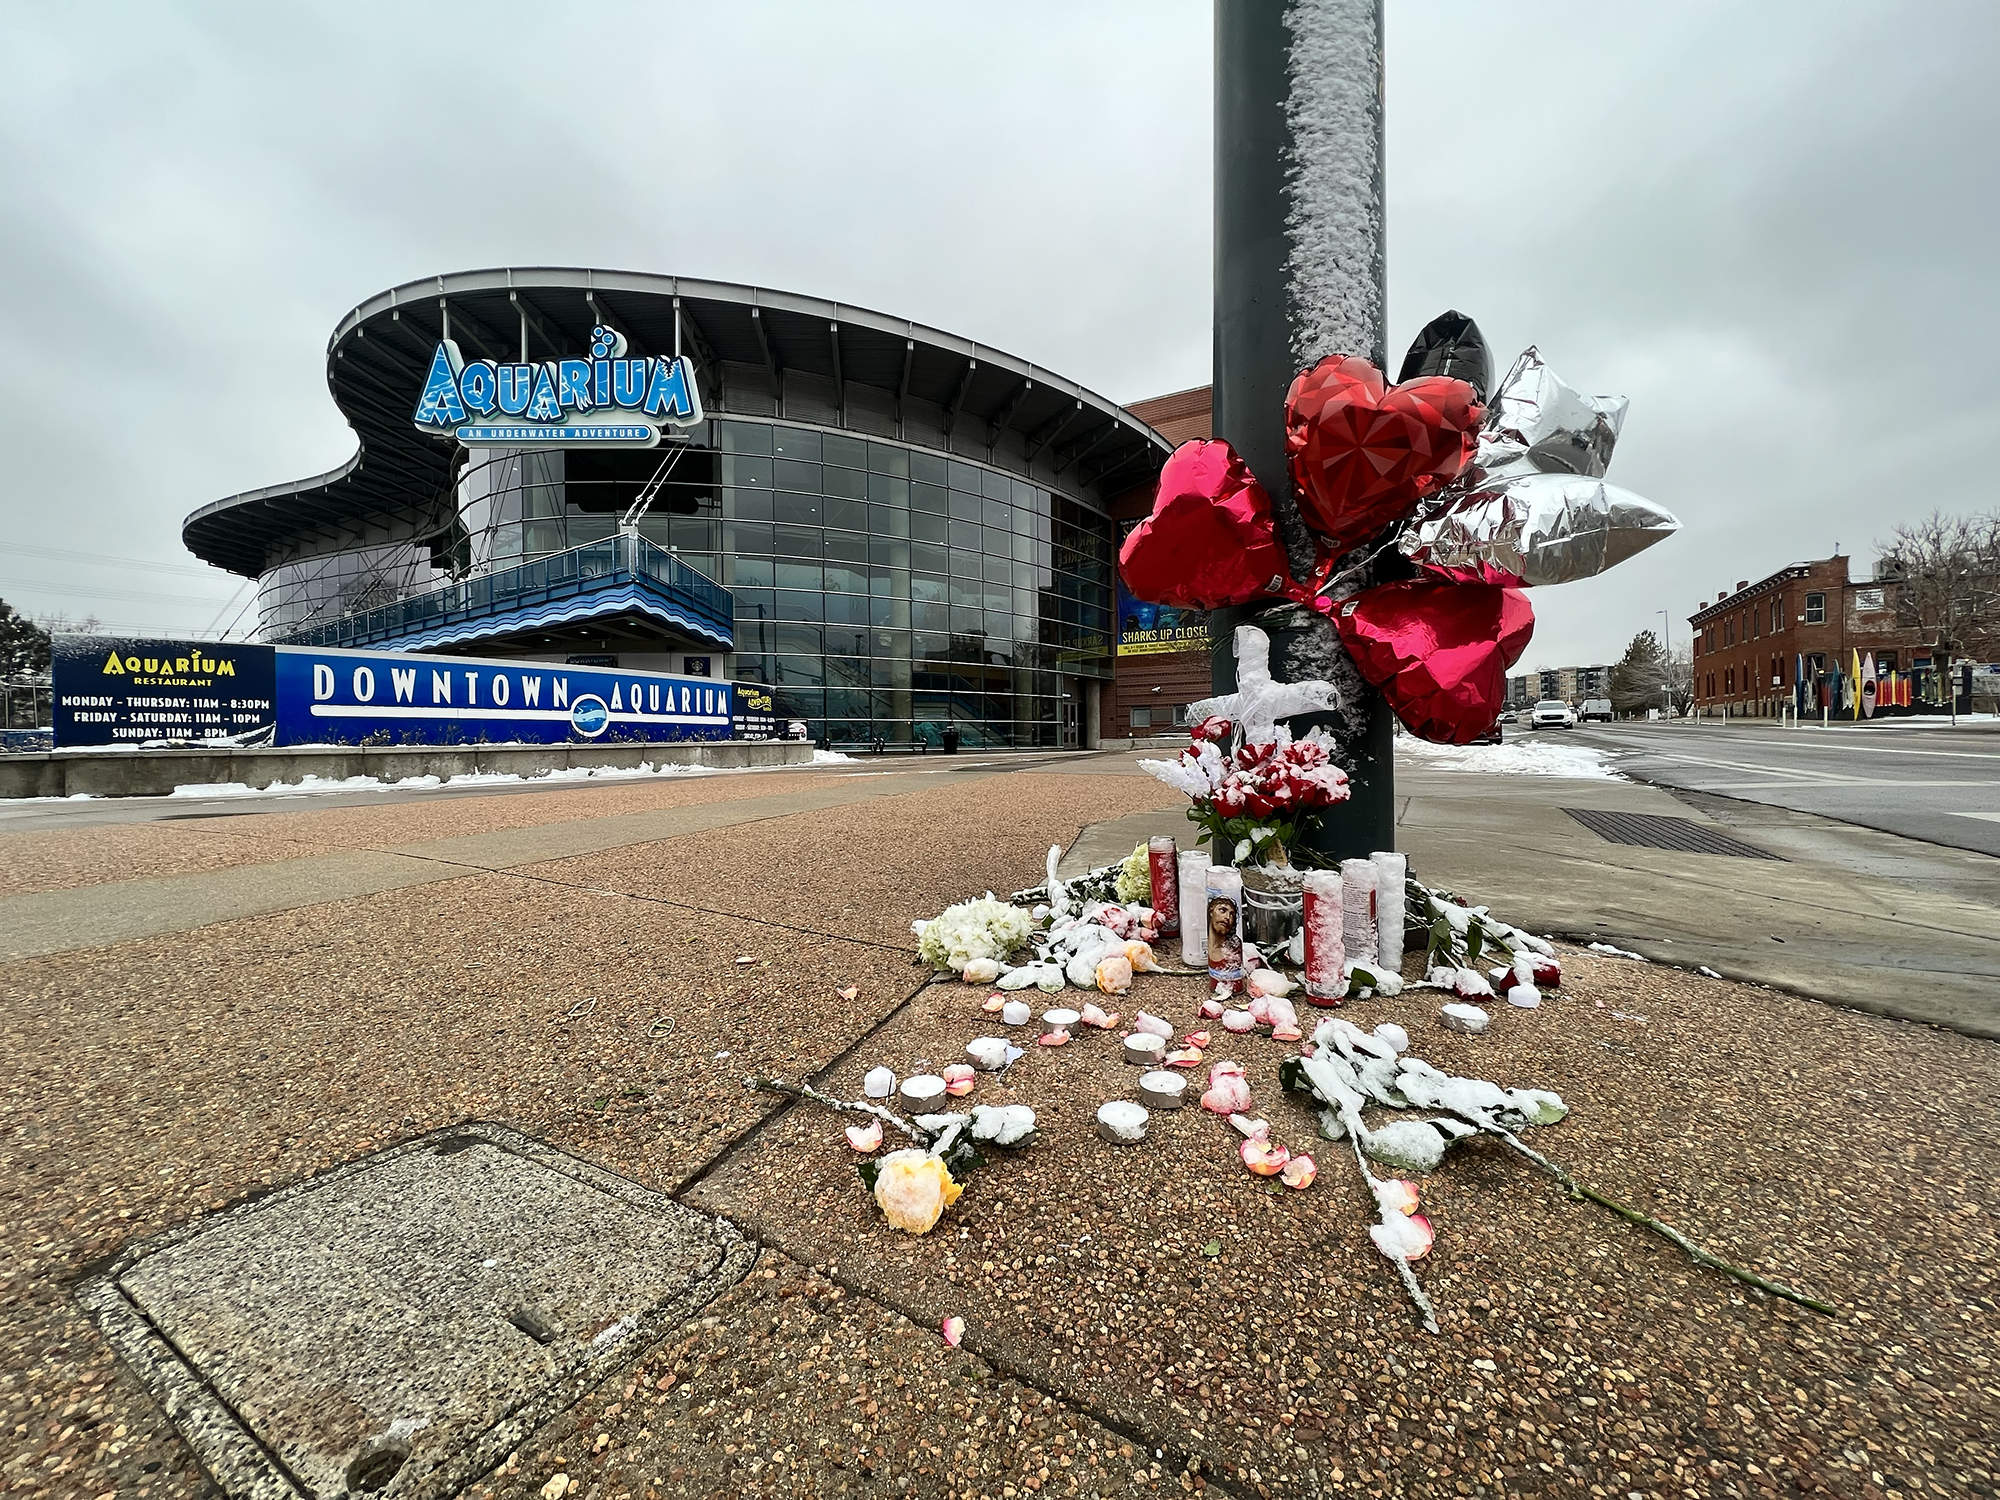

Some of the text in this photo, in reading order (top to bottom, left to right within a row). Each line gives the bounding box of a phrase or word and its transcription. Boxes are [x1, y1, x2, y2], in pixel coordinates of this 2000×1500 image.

[413, 326, 694, 427] AQUARIUM
[468, 429, 641, 438] AN UNDERWATER ADVENTURE
[1122, 625, 1208, 643] SHARKS UP CLOSE!
[102, 649, 236, 676] AQUARIUM
[133, 677, 213, 687] RESTAURANT
[313, 664, 728, 715] DOWNTOWN AQUARIUM
[61, 696, 114, 707] MONDAY
[126, 697, 190, 708] THURSDAY:
[193, 698, 218, 709] 11AM
[230, 699, 270, 709] 8:30PM
[73, 712, 118, 723] FRIDAY
[130, 712, 192, 723] SATURDAY:
[195, 713, 221, 724] 11AM
[232, 714, 260, 724] 10PM
[112, 727, 163, 738] SUNDAY:
[166, 728, 192, 738] 11AM
[204, 728, 228, 738] 8PM
